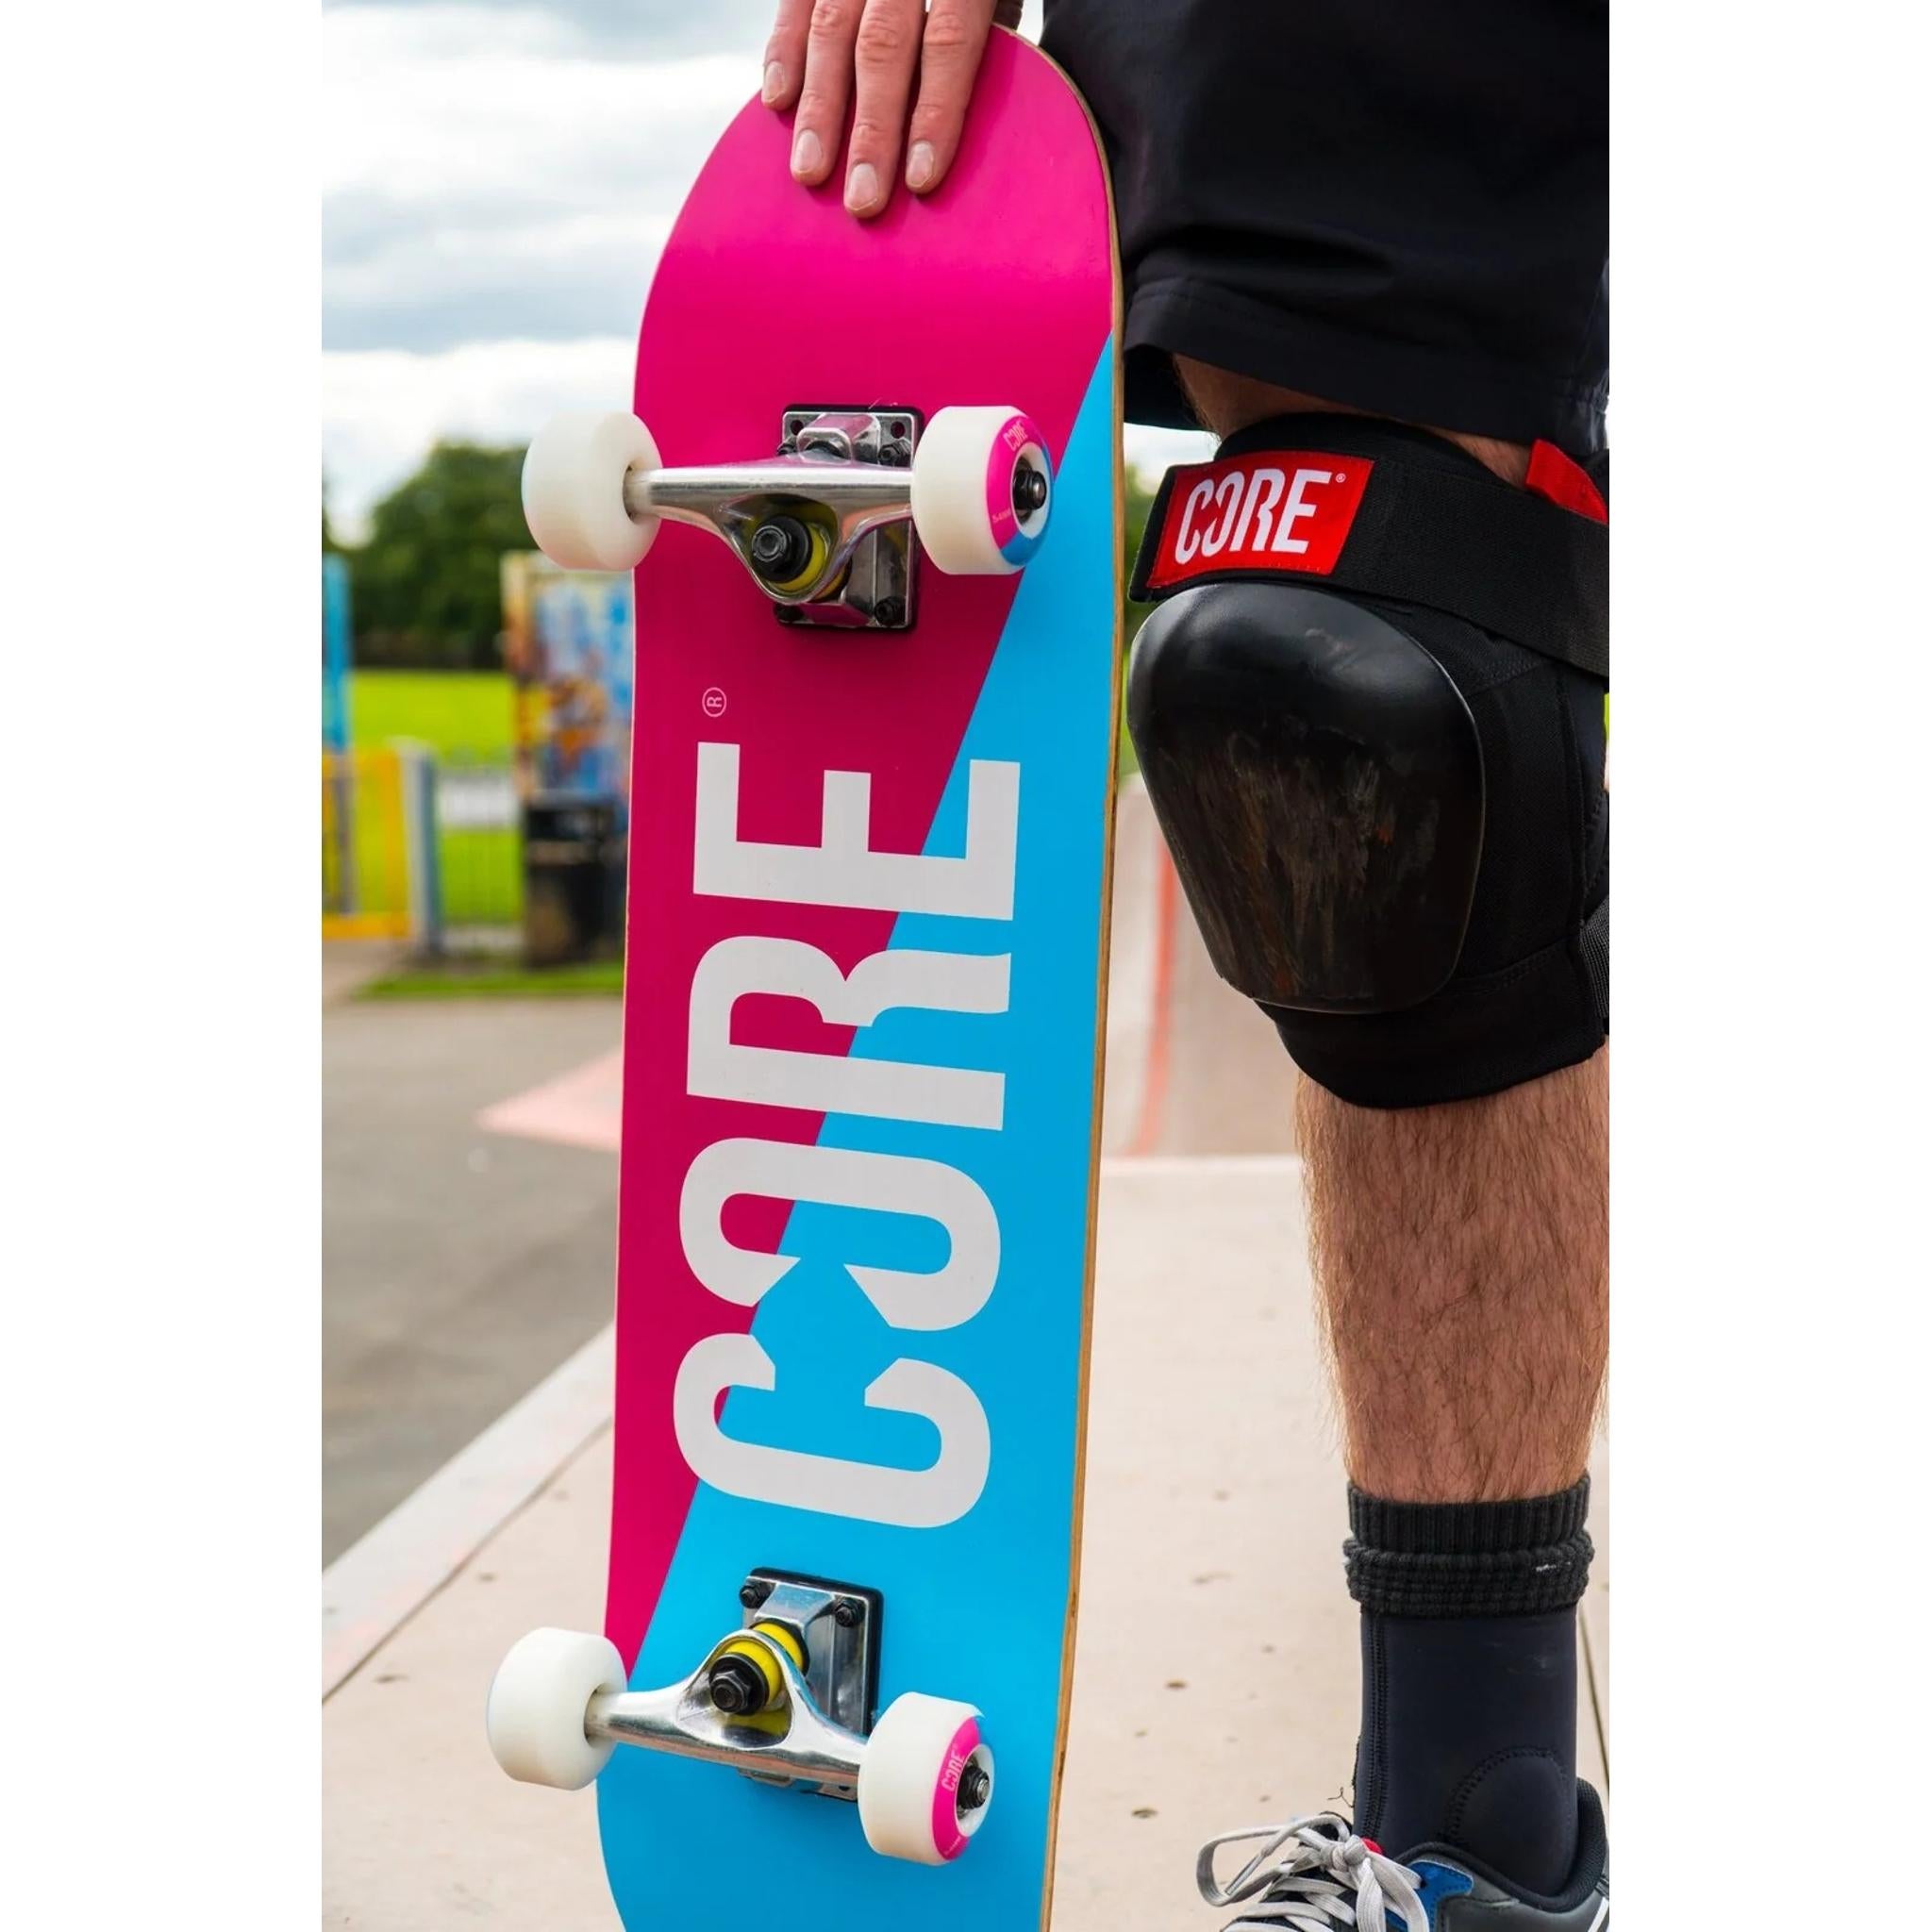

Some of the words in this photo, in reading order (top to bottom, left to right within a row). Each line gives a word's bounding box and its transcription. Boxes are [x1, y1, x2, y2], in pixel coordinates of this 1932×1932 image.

[1174, 468, 1333, 565] CORE
[673, 741, 1022, 1528] CORE
[941, 1749, 965, 1791] CORE
